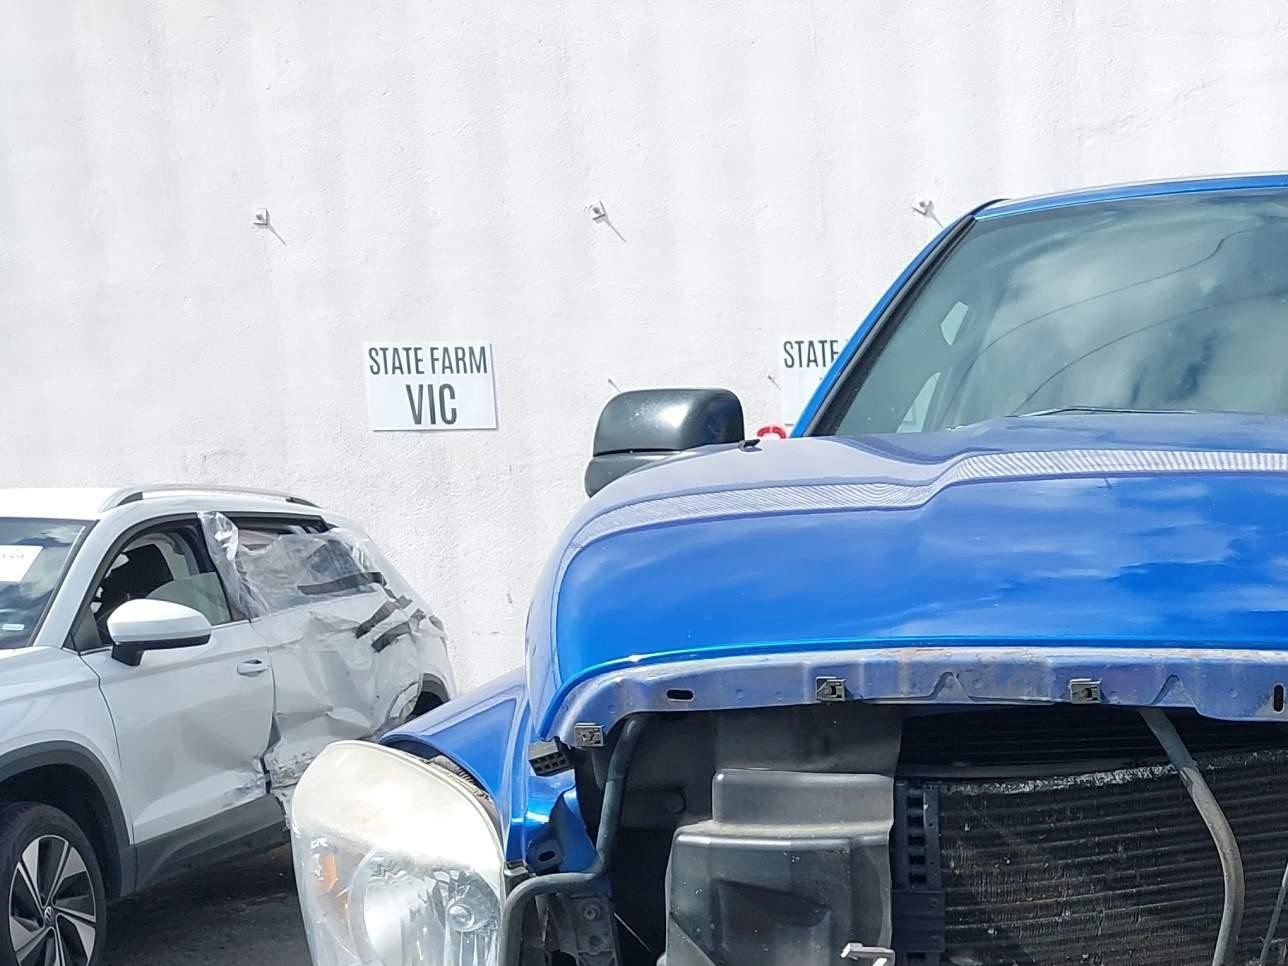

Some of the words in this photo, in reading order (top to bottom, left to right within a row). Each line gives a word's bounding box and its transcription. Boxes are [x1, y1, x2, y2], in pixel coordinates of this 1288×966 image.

[368, 346, 425, 375] STATE
[429, 345, 486, 375] FARM
[405, 383, 458, 425] VIC
